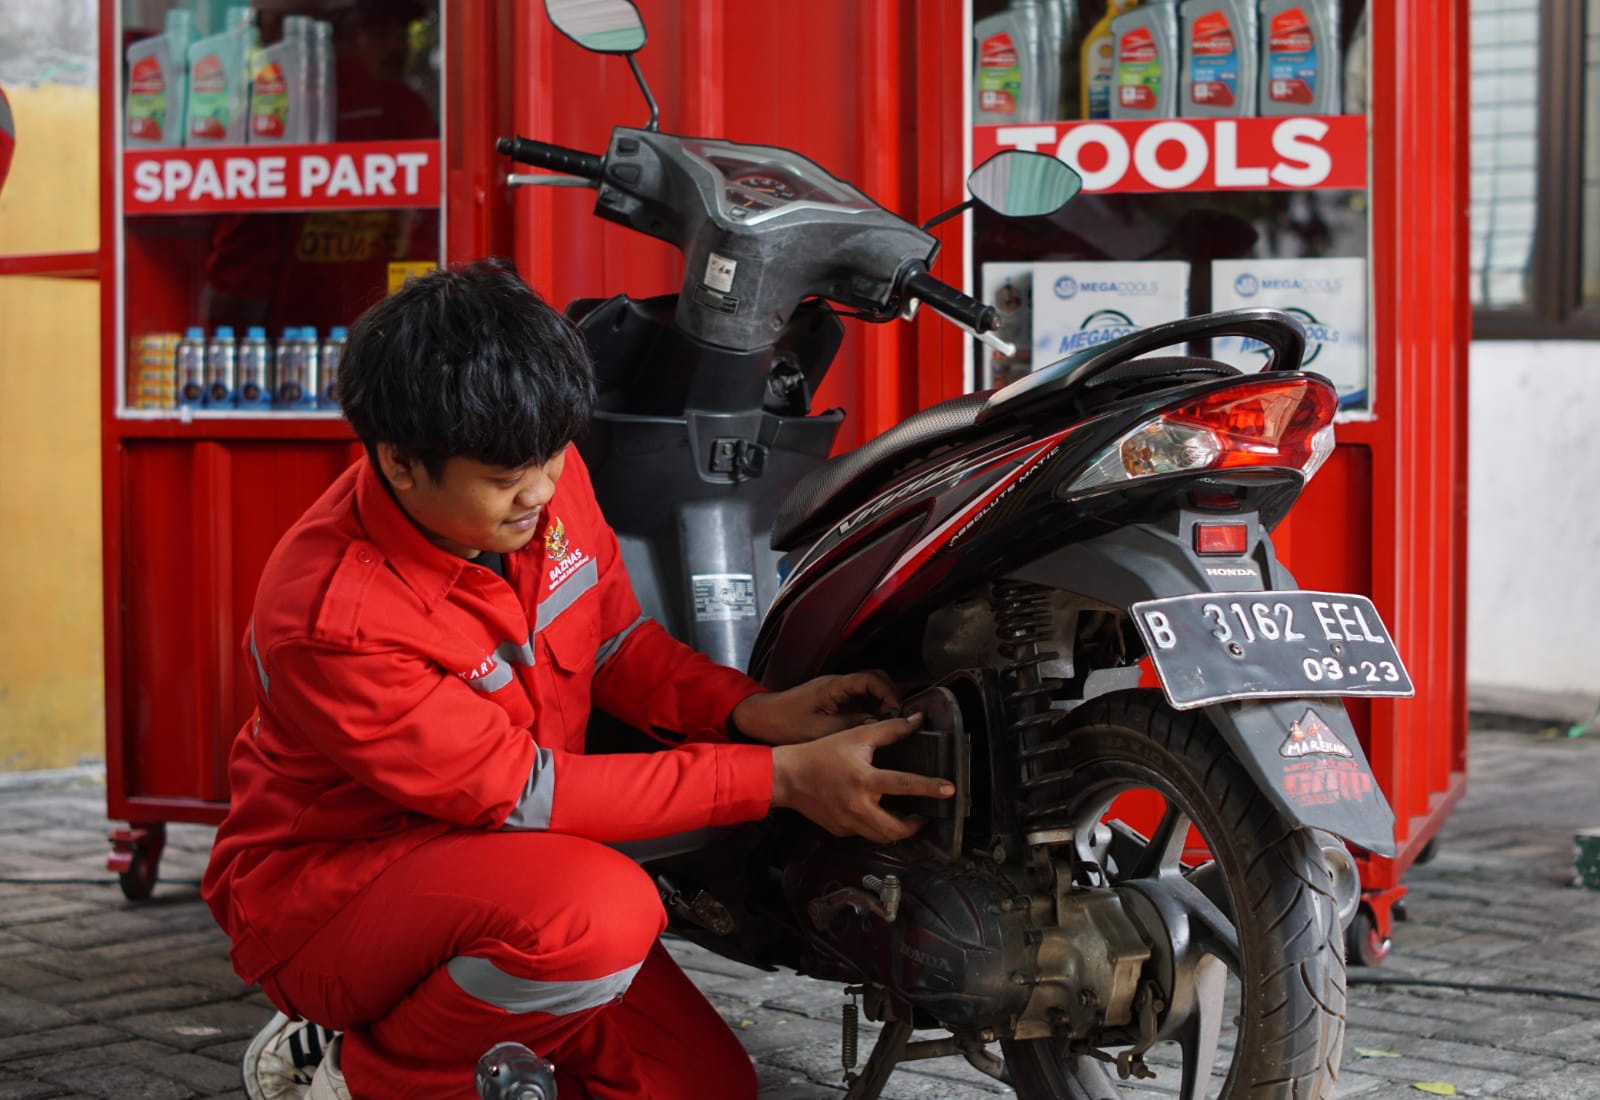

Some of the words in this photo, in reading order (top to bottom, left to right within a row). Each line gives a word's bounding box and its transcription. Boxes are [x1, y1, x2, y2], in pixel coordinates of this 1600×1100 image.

[134, 157, 287, 202] SPARE
[300, 153, 429, 197] PART
[996, 118, 1331, 190] TOOLS
[1080, 281, 1159, 293] MEGACOOLS
[949, 483, 1016, 547] ABSOLUTE
[1018, 446, 1060, 484] MATIC
[549, 548, 582, 581] BAZNAS
[1205, 568, 1257, 576] HONDA
[1145, 611, 1177, 649] B
[1202, 602, 1306, 643] 3162
[1312, 601, 1385, 643] EEL
